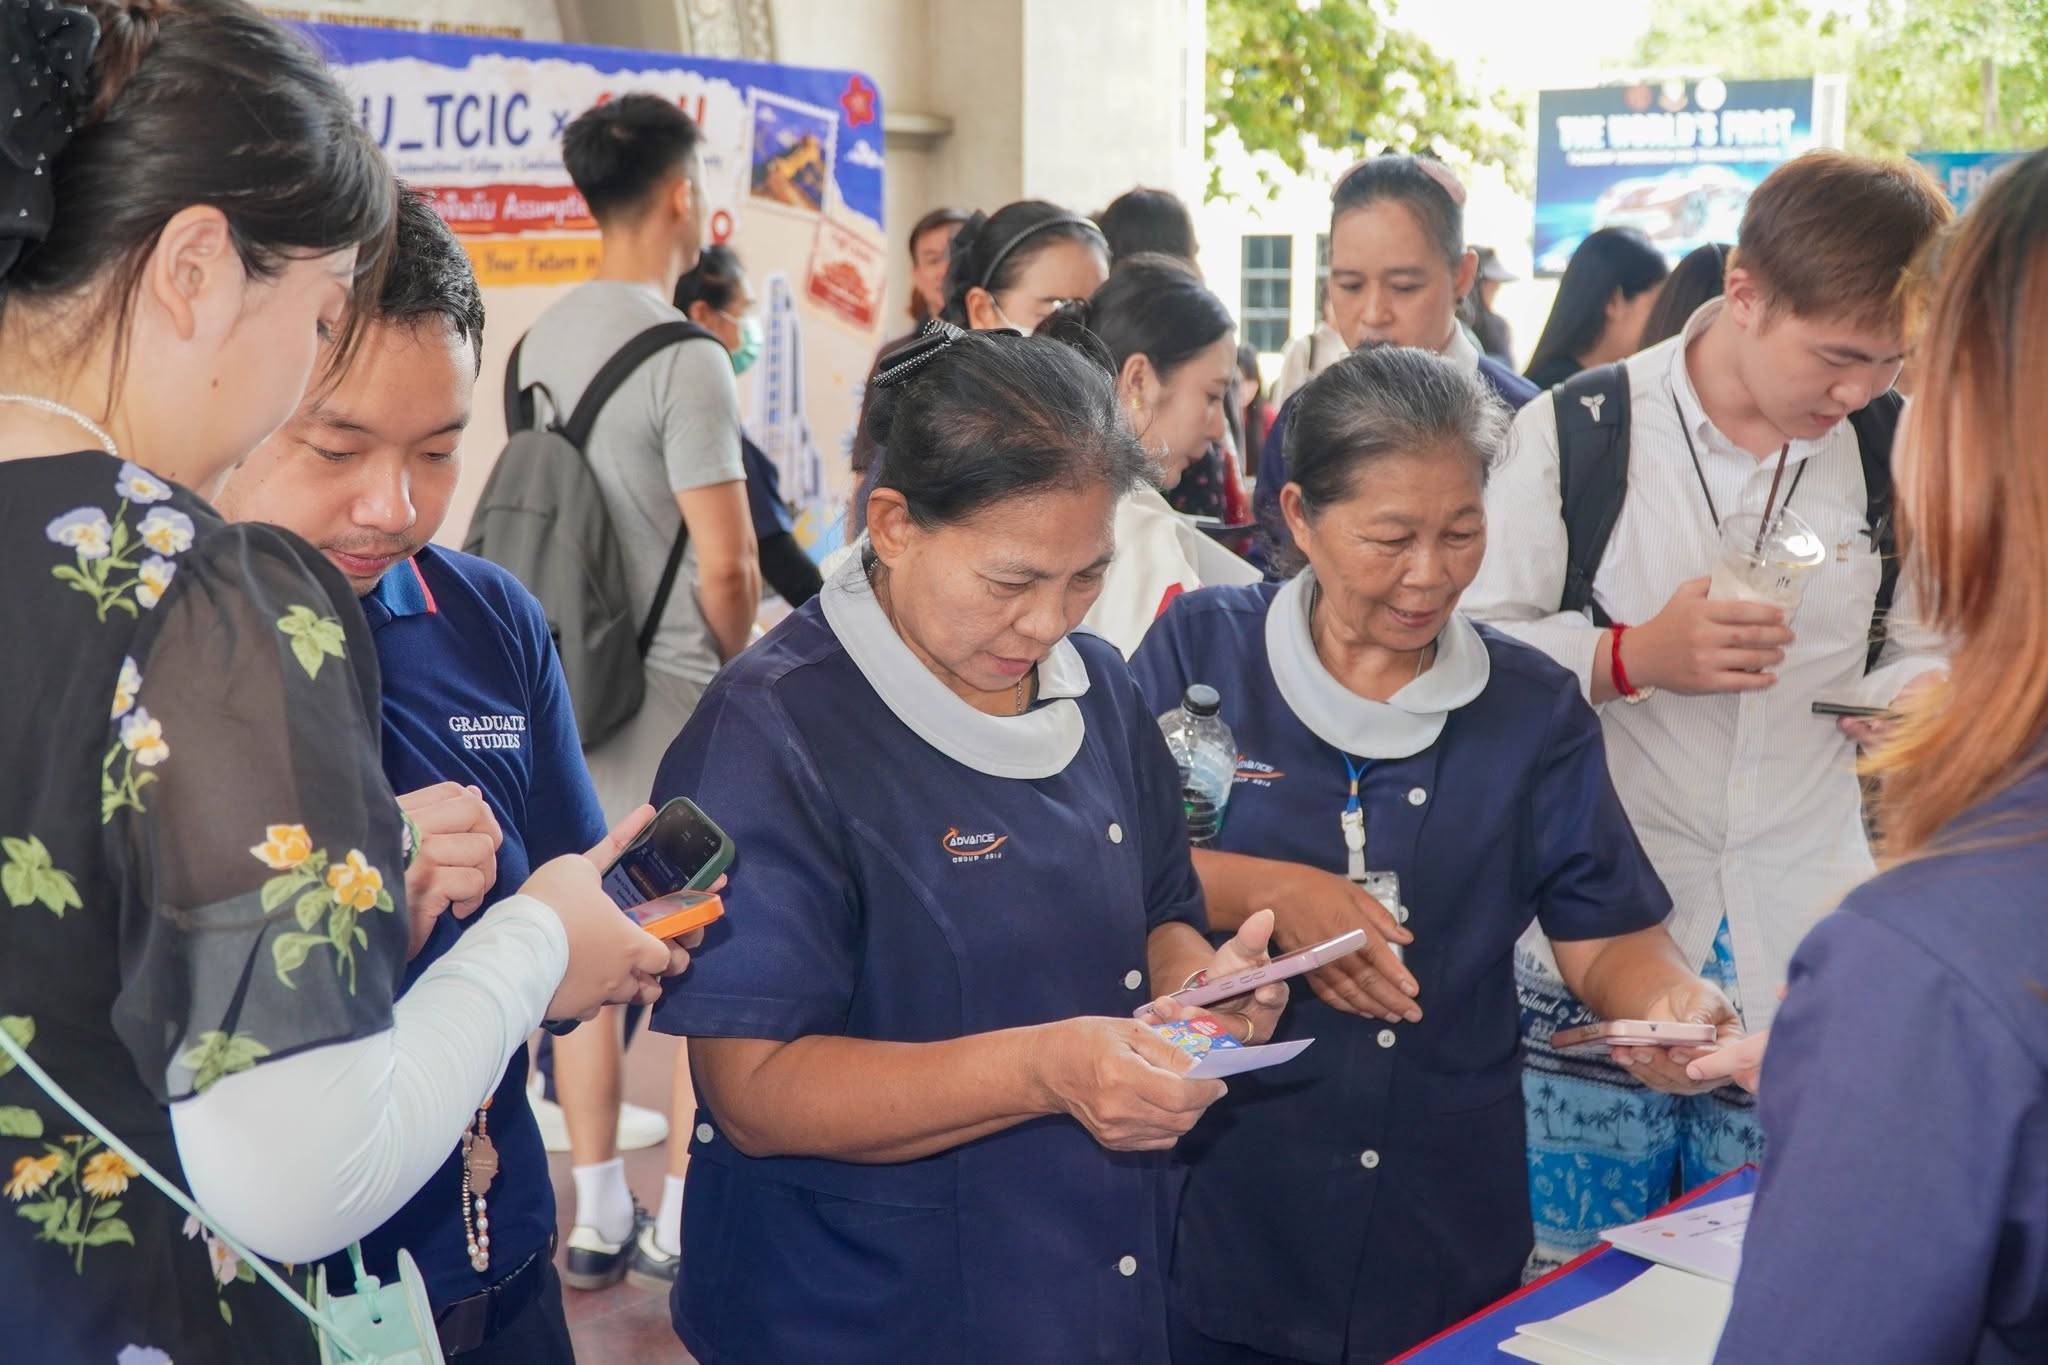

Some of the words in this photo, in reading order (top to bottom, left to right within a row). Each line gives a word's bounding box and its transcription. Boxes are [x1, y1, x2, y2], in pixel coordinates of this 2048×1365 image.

[1556, 115, 1606, 149] THE
[1607, 111, 1719, 148] WORLD'S
[1721, 108, 1795, 146] FIRST
[449, 715, 526, 732] GRADUATE
[462, 733, 520, 749] STUDIES
[949, 833, 996, 847] ADVANCE
[952, 855, 979, 863] GROUP
[983, 852, 1002, 860] ASIA
